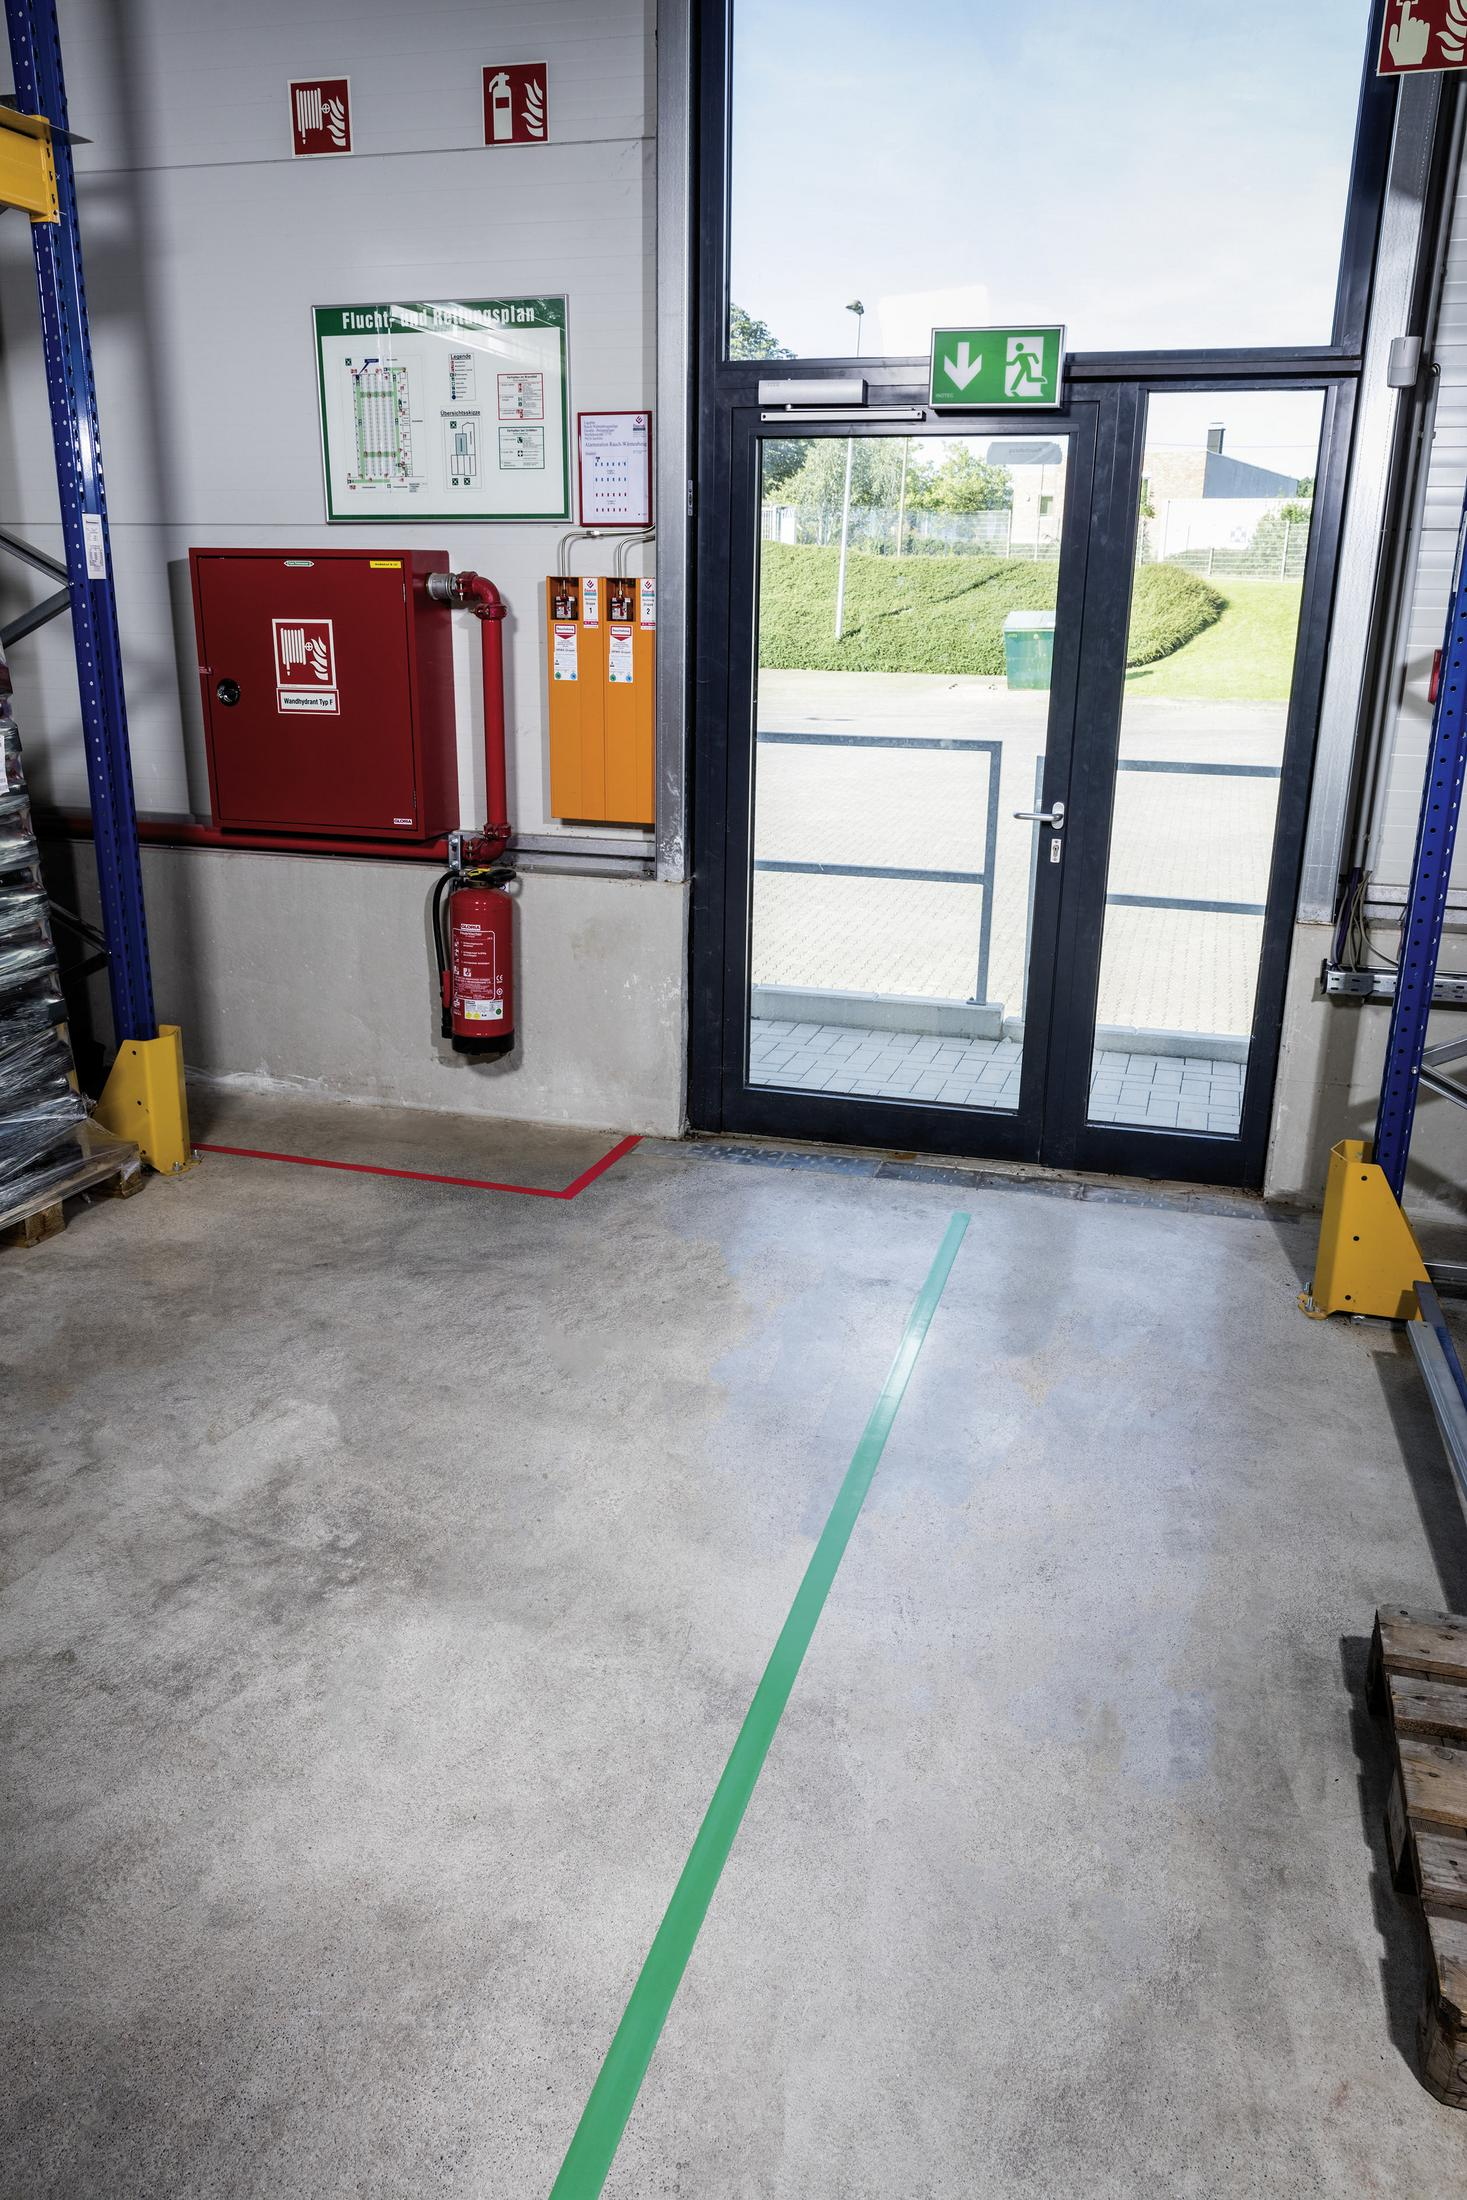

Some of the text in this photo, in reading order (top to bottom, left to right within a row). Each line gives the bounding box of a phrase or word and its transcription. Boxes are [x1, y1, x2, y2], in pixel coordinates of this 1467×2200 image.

[341, 310, 396, 330] Flucht-
[283, 697, 319, 706] Wandhydrant
[319, 698, 329, 706] Typ
